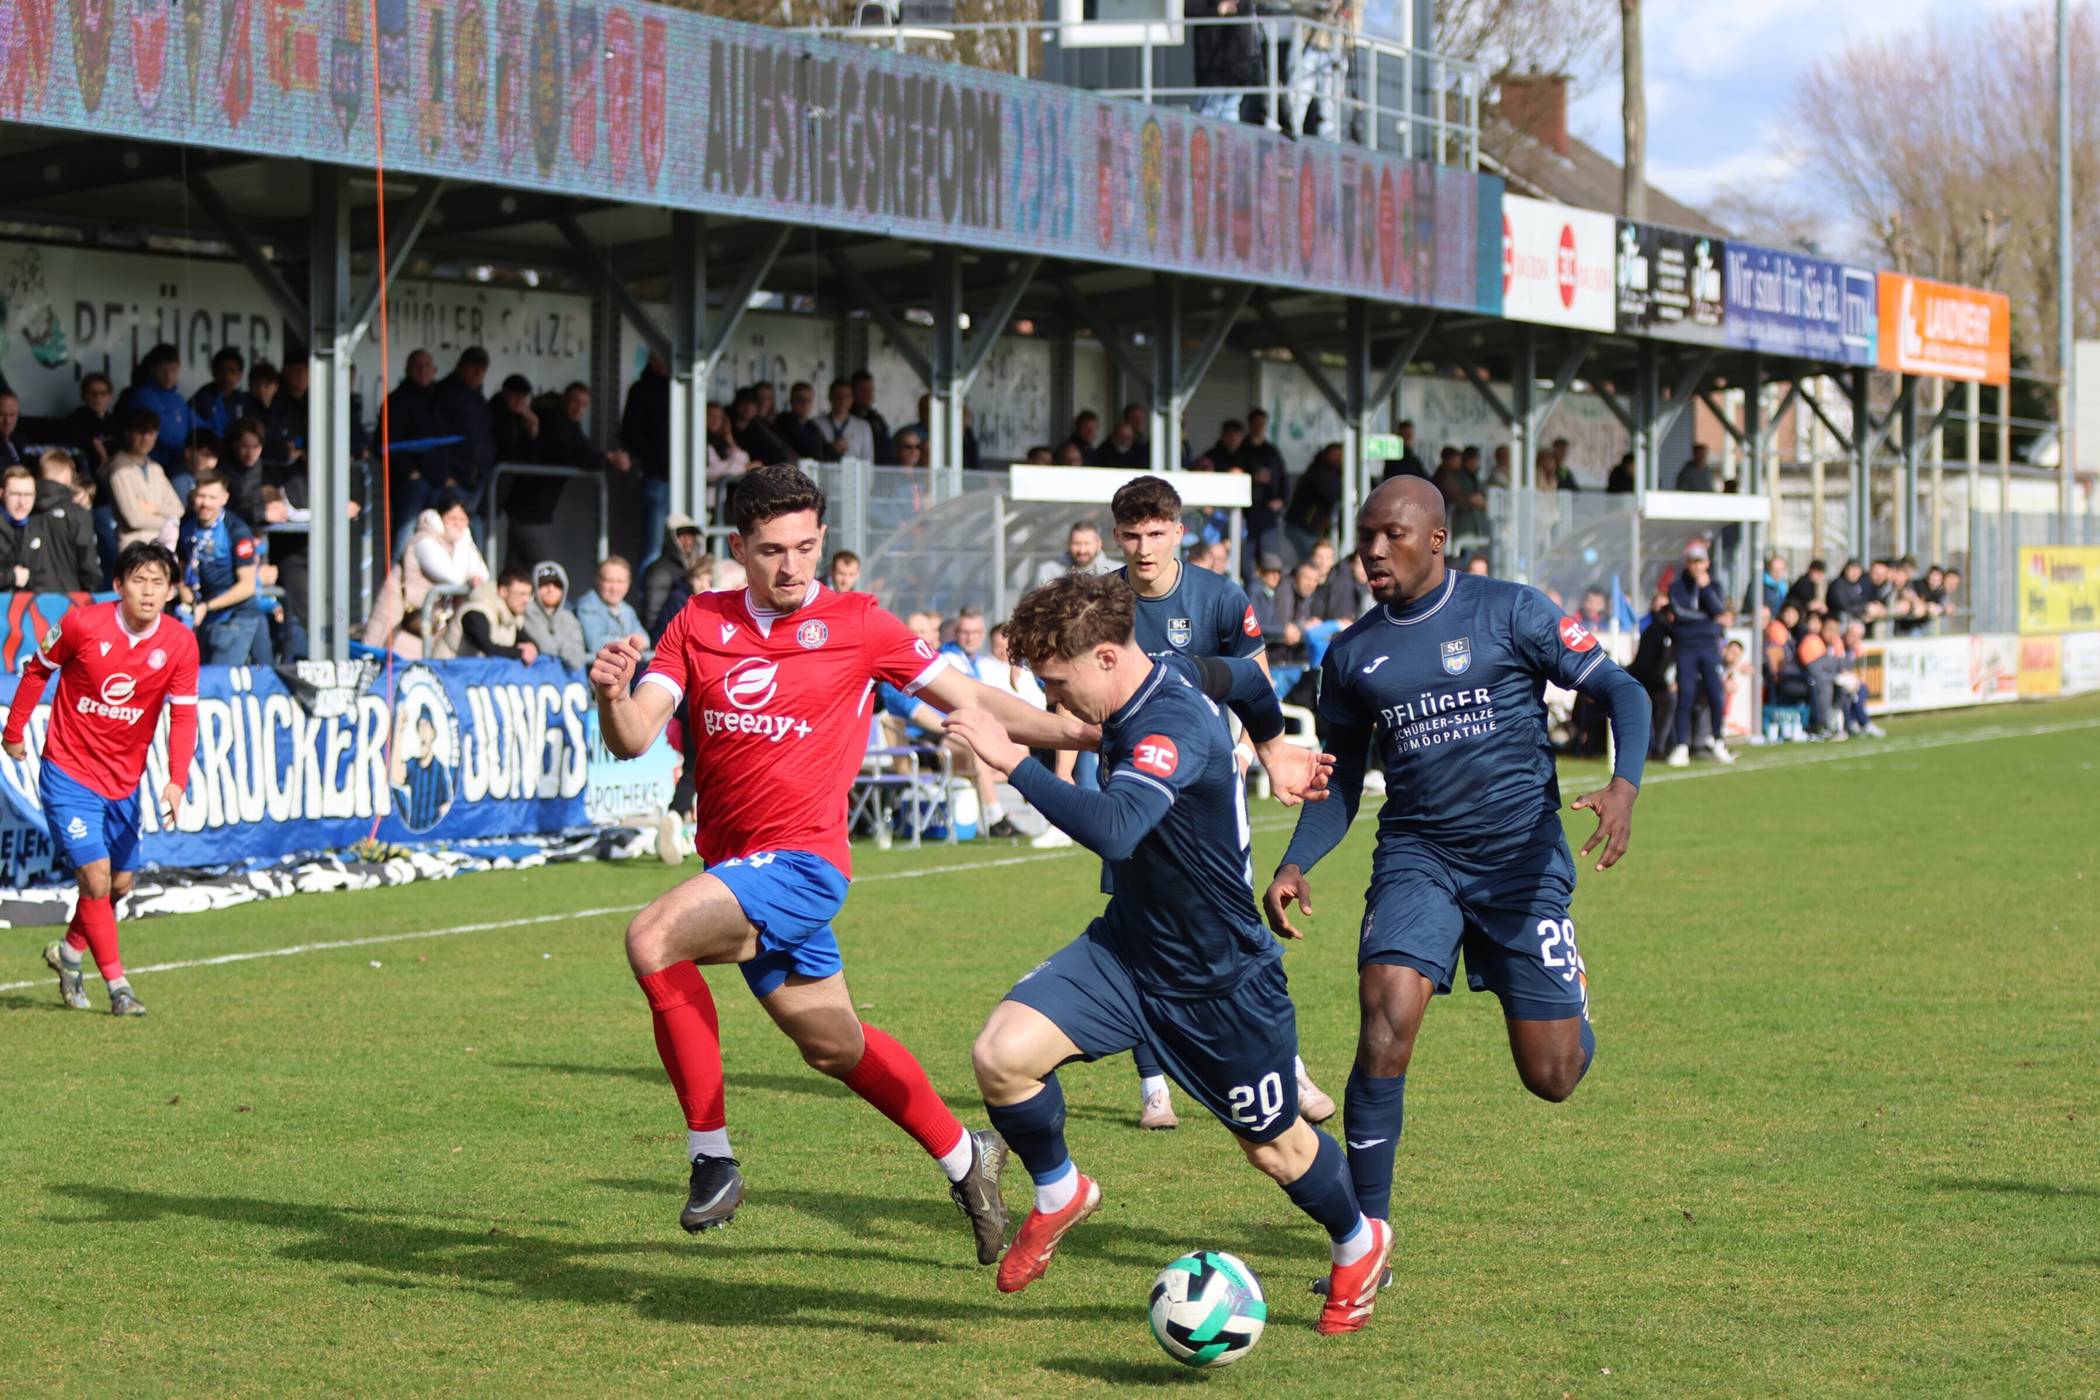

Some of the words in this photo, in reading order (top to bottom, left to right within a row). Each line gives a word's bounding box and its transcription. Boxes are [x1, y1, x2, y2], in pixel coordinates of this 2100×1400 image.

[703, 38, 1002, 229] AUFSTIEGSREFORM
[1728, 251, 1753, 308] Wir
[1755, 254, 1782, 314] sind
[1783, 256, 1803, 317] für
[1803, 264, 1824, 322] Sie
[1447, 641, 1464, 653] SC
[1563, 621, 1589, 647] 3C
[77, 696, 145, 725] greeny
[1381, 687, 1491, 729] PFLÜGER
[463, 682, 588, 803] JUNGS
[1137, 744, 1175, 771] 3C
[1537, 919, 1577, 967] 29
[1228, 1071, 1284, 1123] 20
